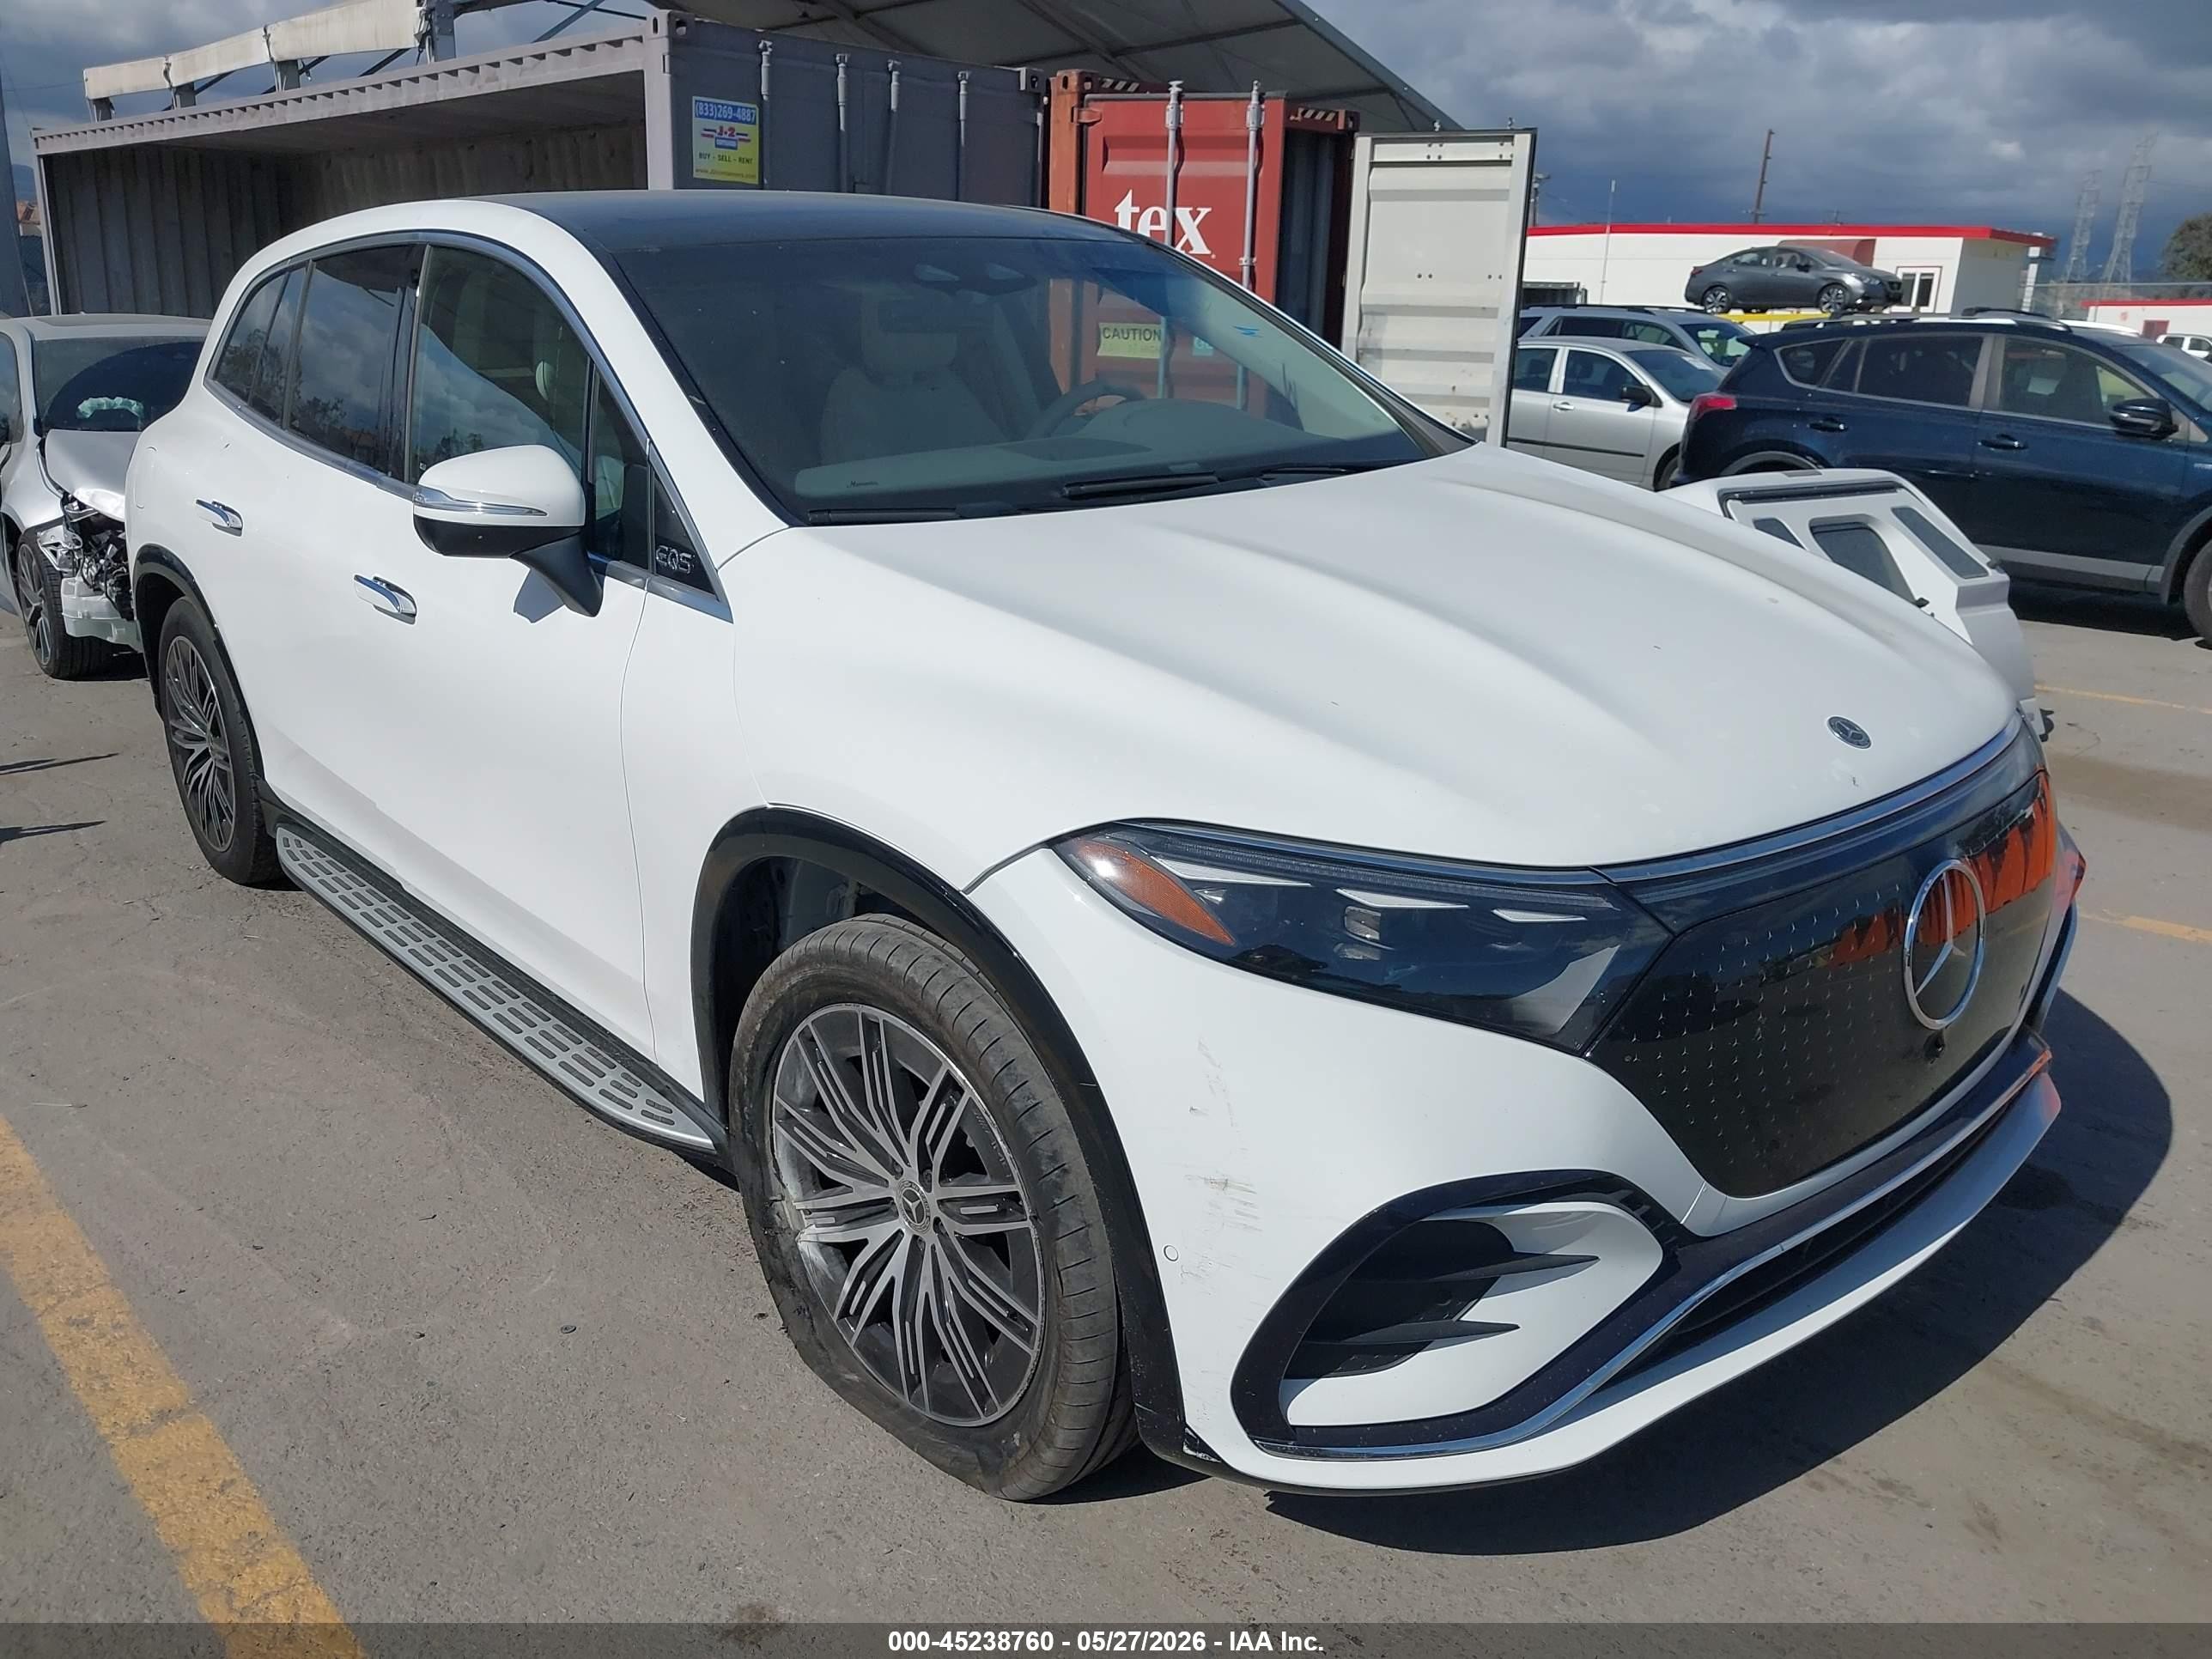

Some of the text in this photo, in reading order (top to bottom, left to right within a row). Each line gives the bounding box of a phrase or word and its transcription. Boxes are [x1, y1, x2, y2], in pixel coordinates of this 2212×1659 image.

[696, 102, 756, 122] (833)269-4887
[718, 154, 732, 162] SELL
[1114, 189, 1212, 254] tex
[1103, 327, 1161, 342] CAUTION
[656, 544, 690, 574] EQS
